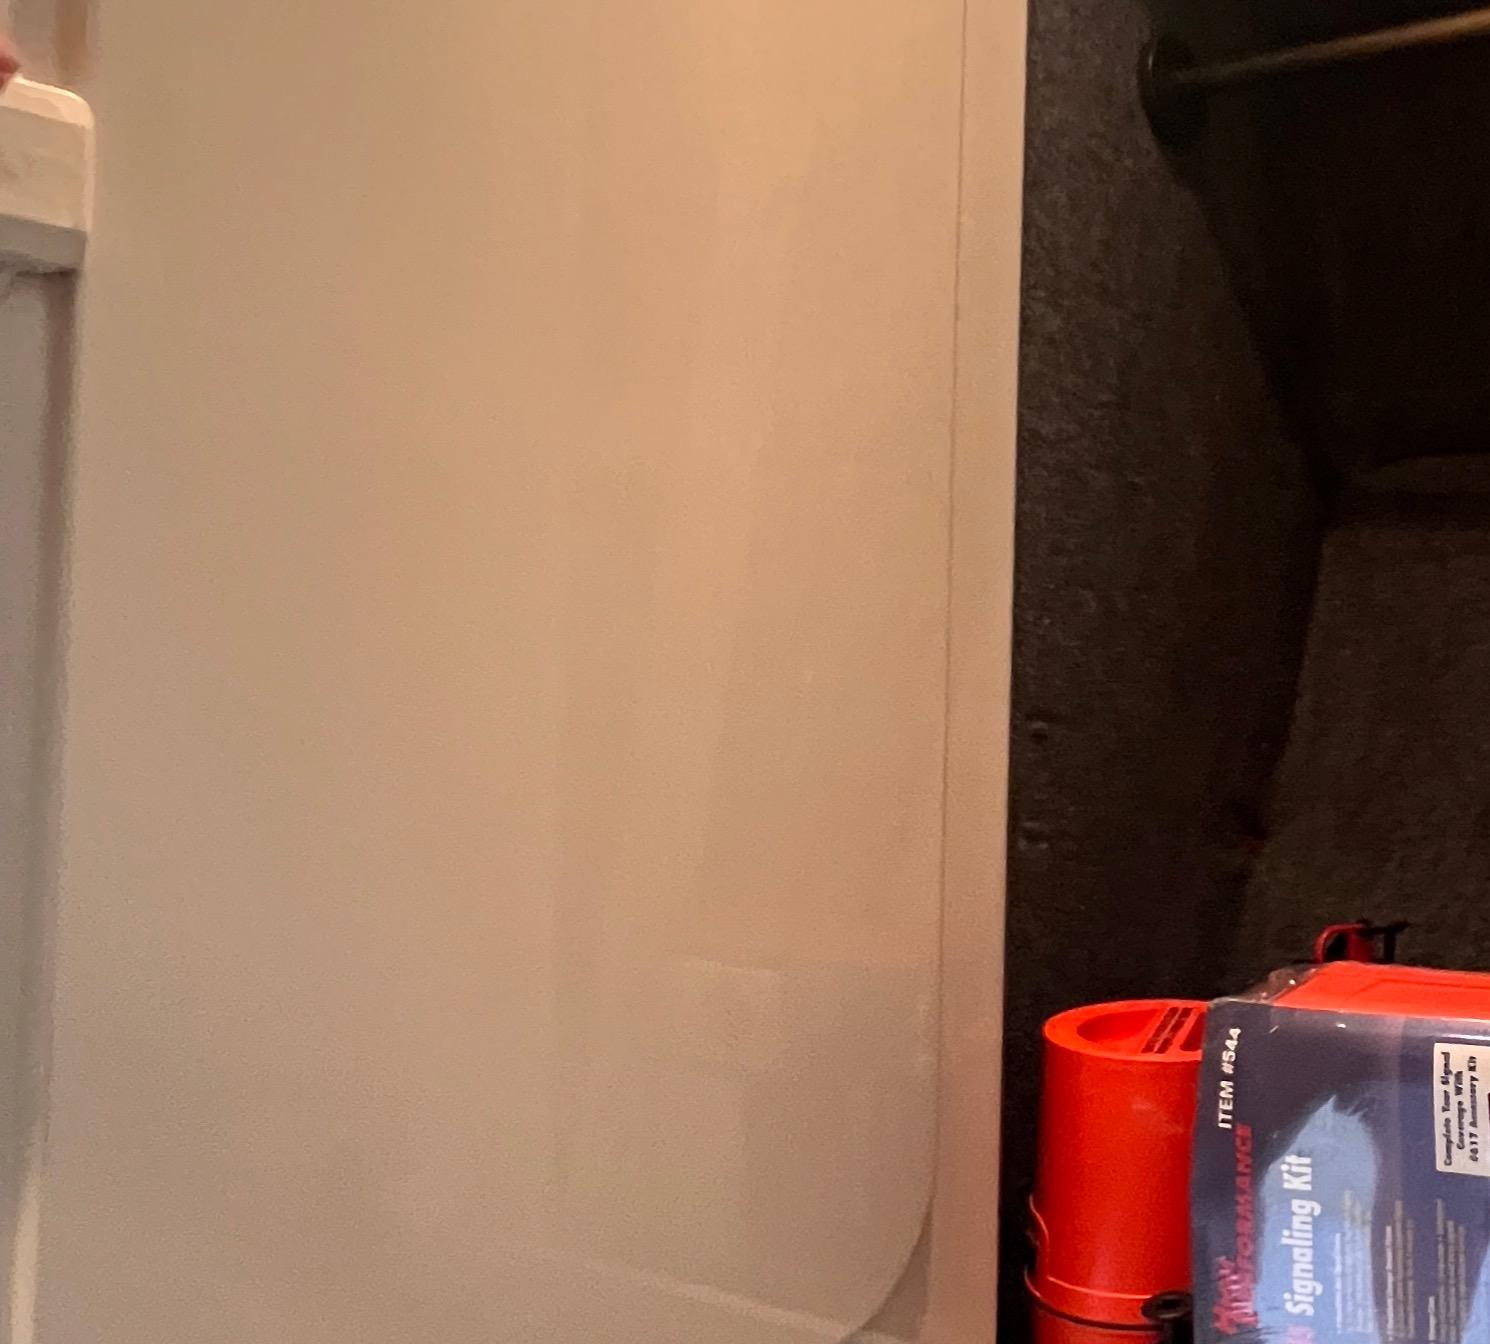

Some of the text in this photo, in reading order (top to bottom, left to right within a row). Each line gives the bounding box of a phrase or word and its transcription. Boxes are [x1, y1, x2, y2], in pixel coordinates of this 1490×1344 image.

[1217, 1027, 1242, 1129] ITEM #544
[1281, 1154, 1313, 1191] Kit
[1281, 1199, 1323, 1316] Signaling
